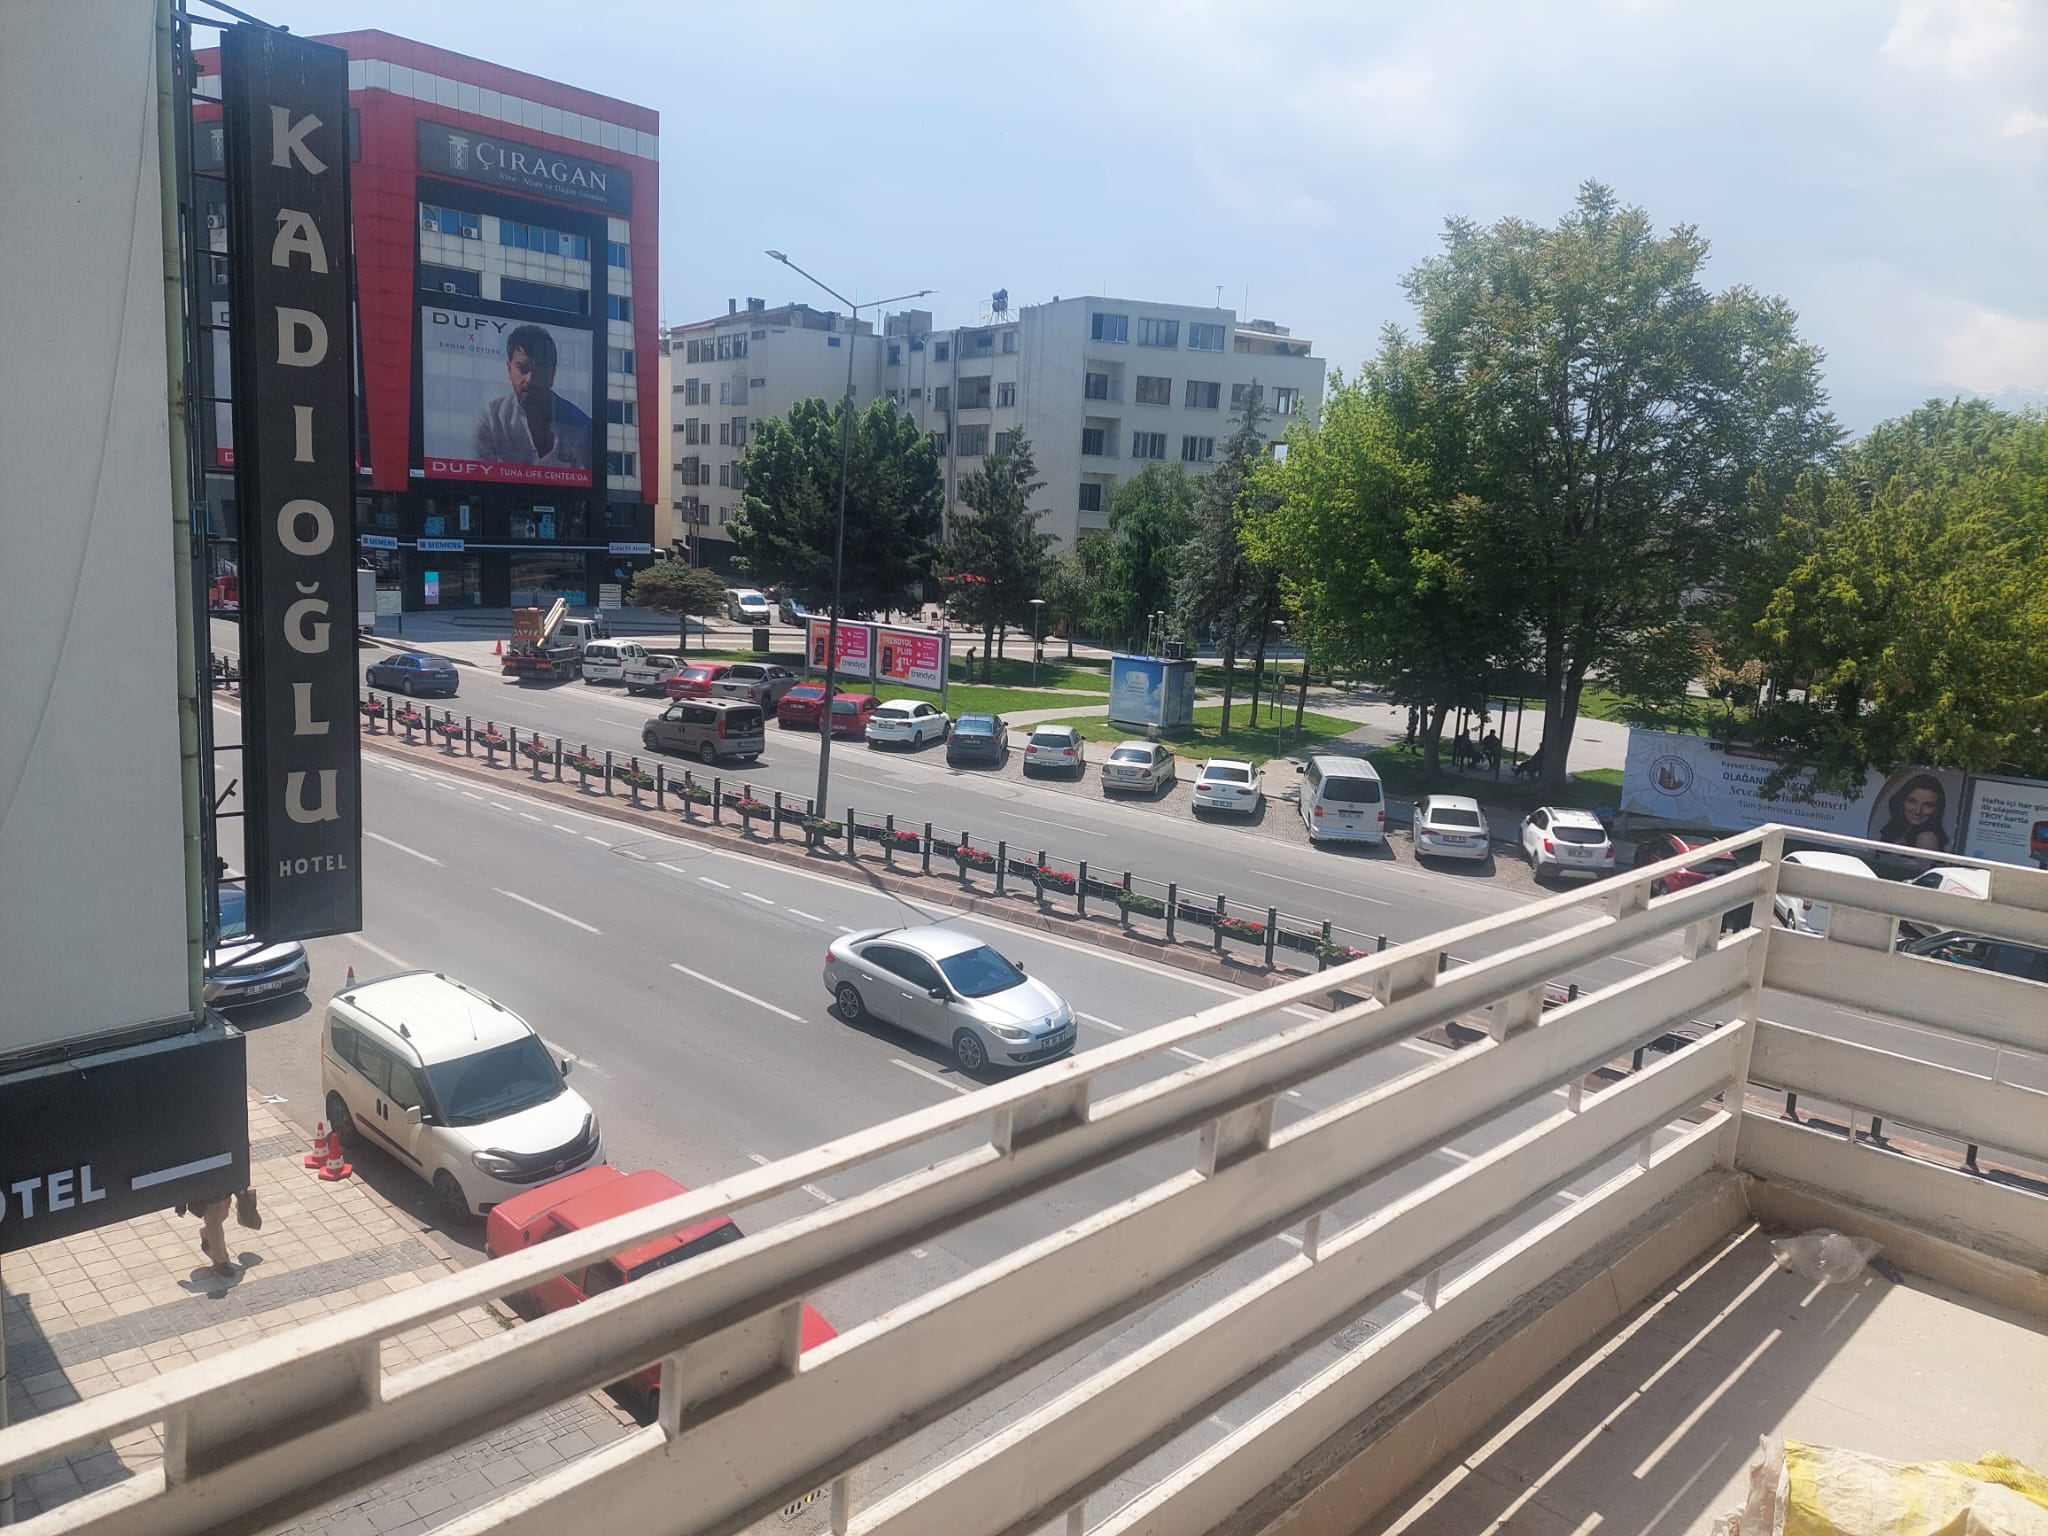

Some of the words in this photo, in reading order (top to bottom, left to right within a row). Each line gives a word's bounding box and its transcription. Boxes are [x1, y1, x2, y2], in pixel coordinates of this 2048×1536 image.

[475, 142, 608, 193] ÇIRAĞAN
[432, 311, 507, 334] DUFY
[269, 105, 340, 824] KADIOĞLU
[432, 461, 493, 475] DUFY
[500, 468, 522, 478] TUNA
[525, 469, 542, 479] LIFE
[368, 537, 396, 547] SIEMENS
[427, 541, 462, 550] SIEMENS
[279, 854, 347, 878] HOTEL
